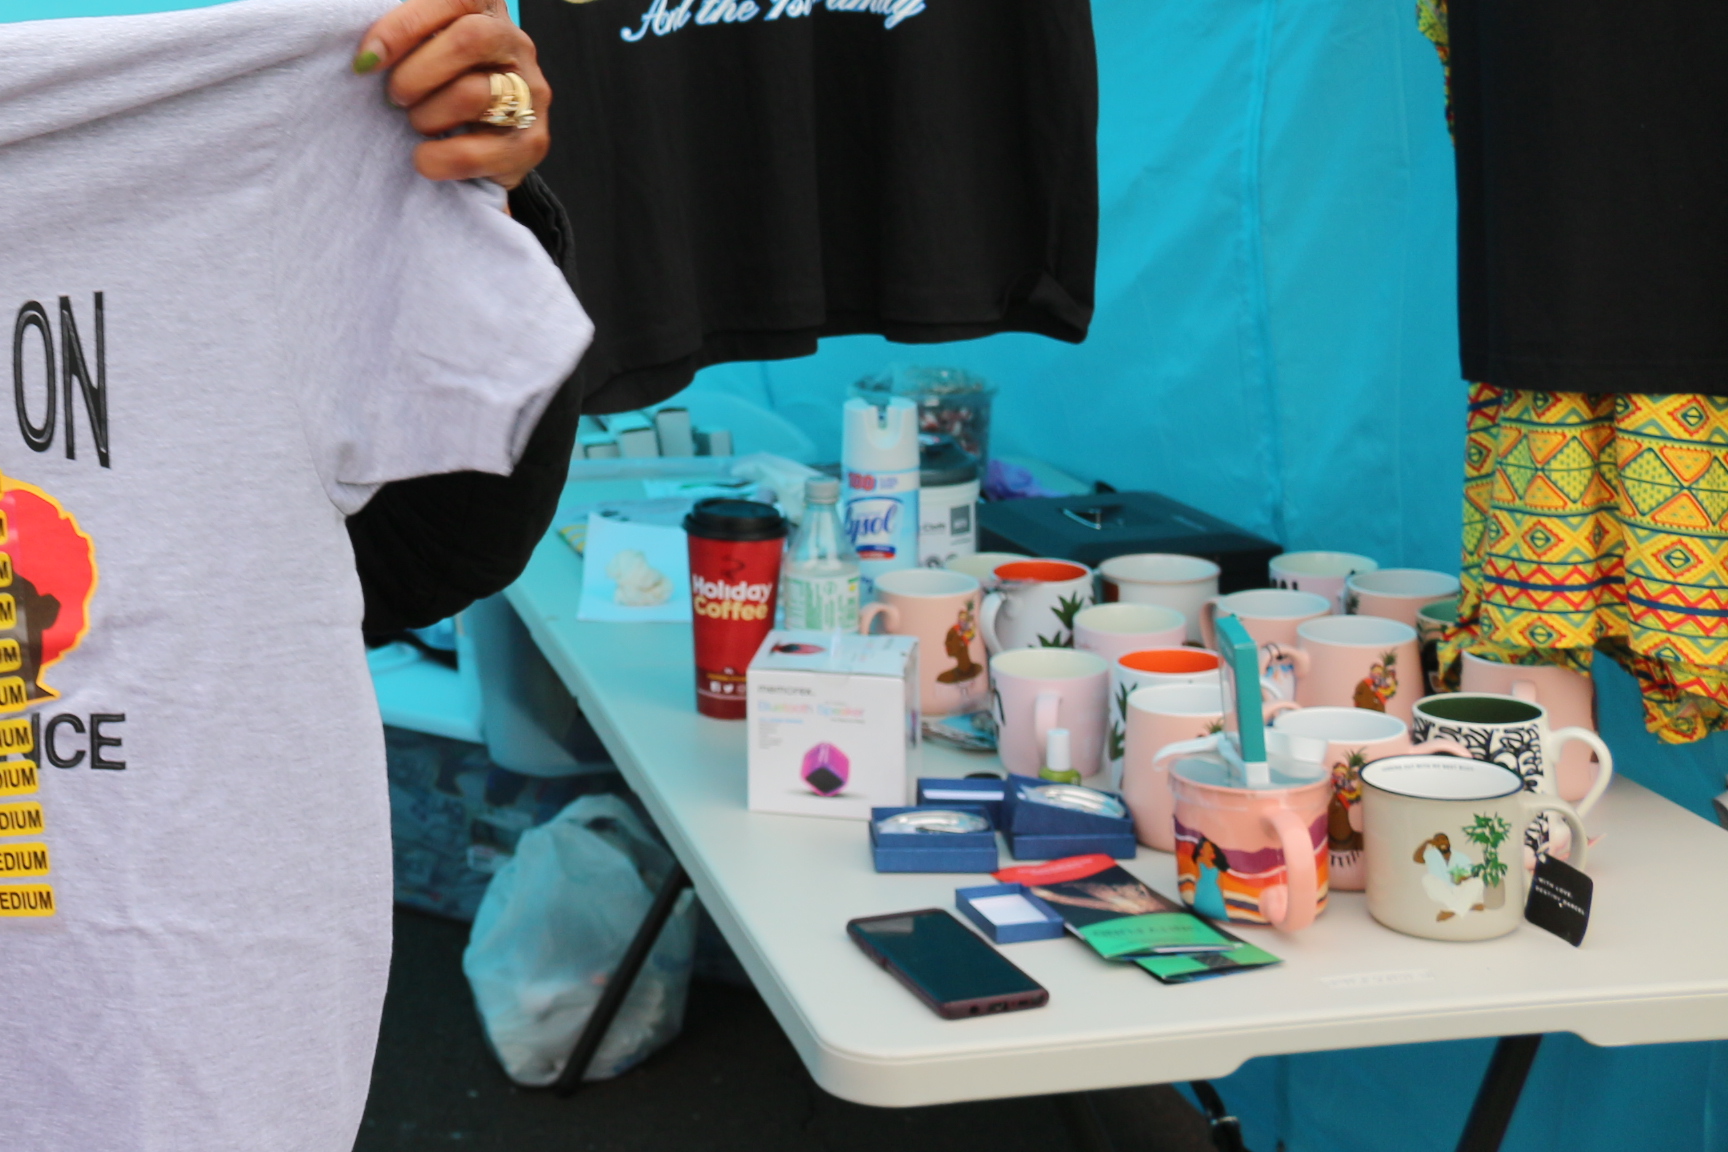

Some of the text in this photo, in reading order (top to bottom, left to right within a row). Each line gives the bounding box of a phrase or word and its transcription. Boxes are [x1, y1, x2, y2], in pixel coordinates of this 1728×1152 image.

[13, 291, 111, 469] ON
[692, 574, 773, 604] Holiday
[694, 596, 769, 621] Coffee
